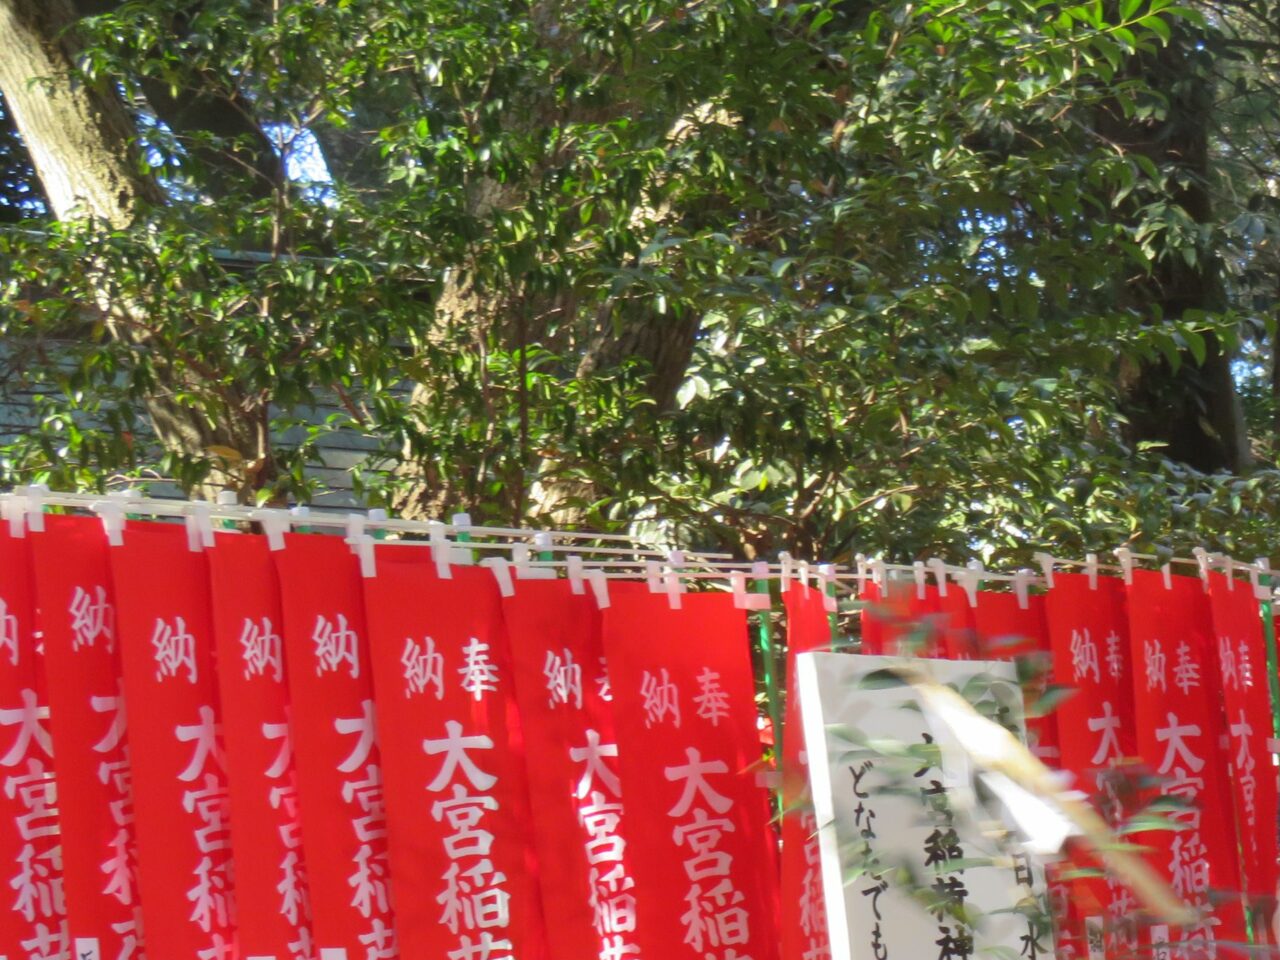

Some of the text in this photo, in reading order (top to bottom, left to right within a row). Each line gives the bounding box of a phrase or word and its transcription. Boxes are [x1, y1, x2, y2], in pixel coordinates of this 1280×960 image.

[152, 616, 198, 684] 納
[240, 616, 284, 683] 納
[312, 614, 360, 679] 納
